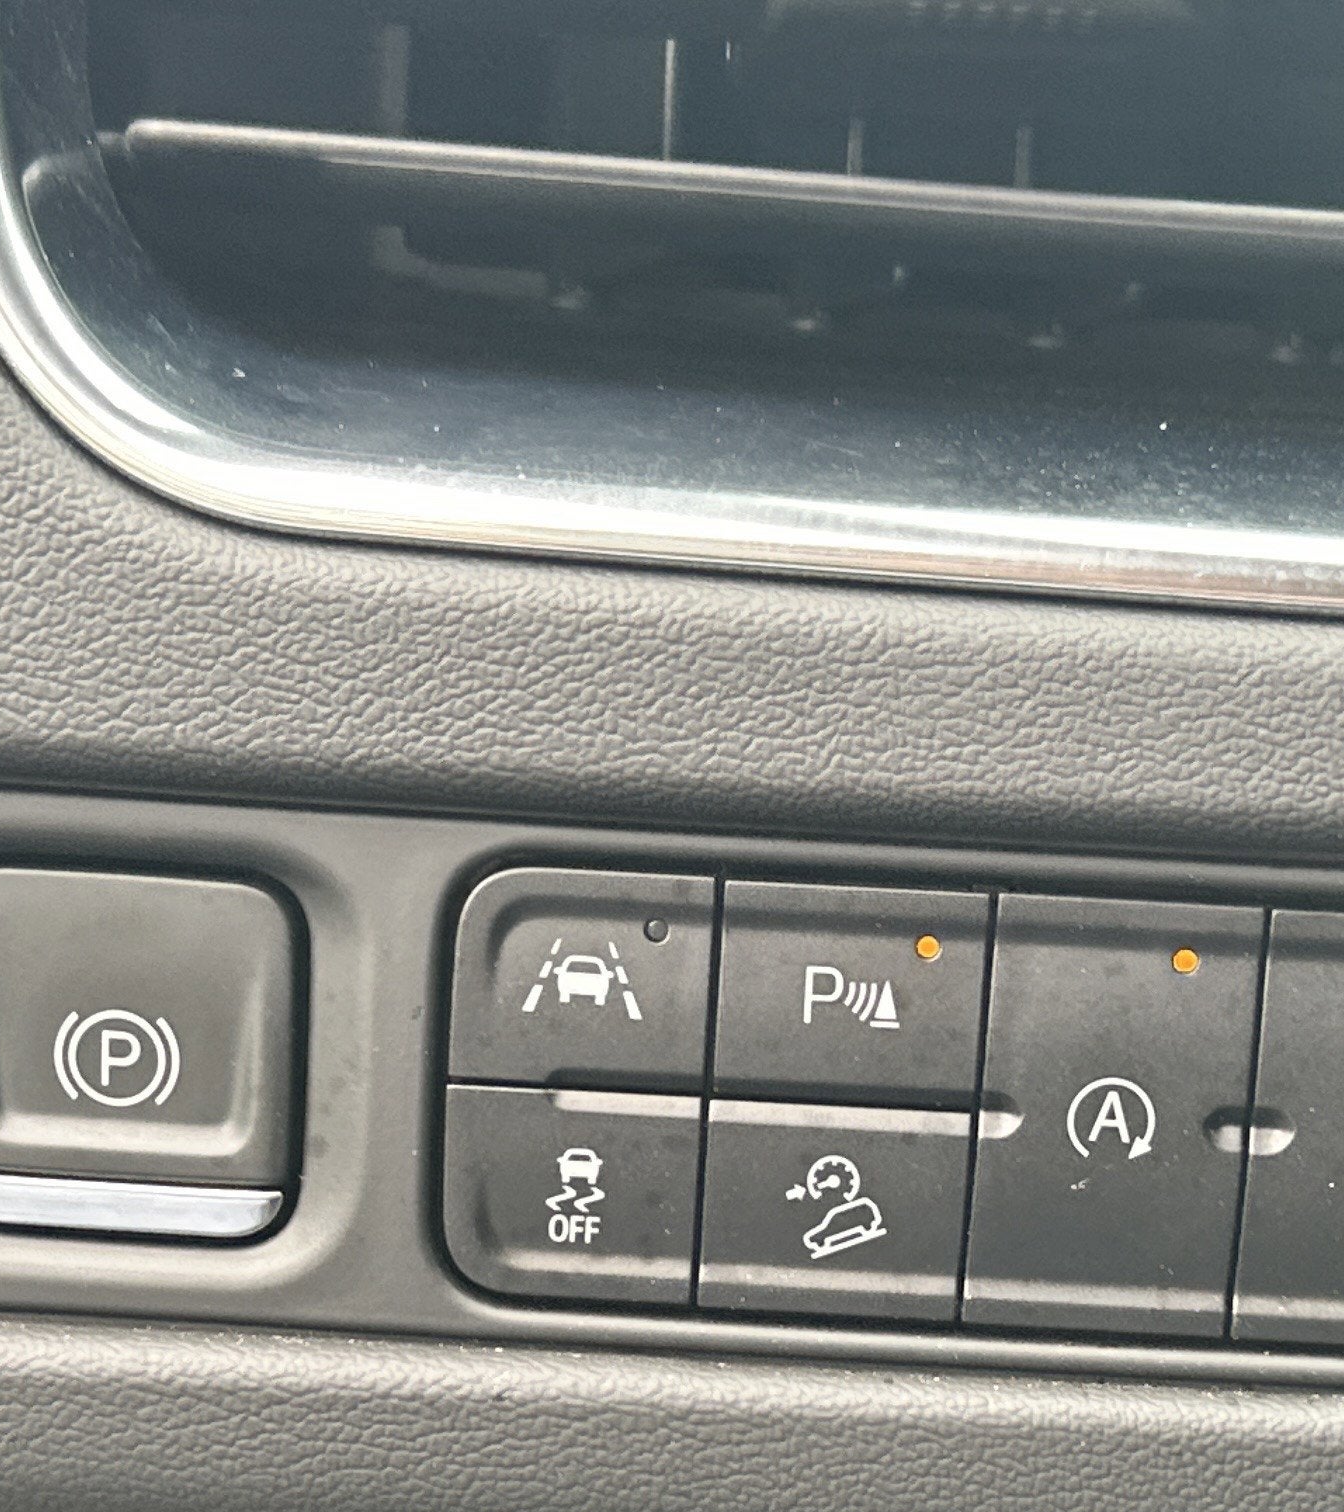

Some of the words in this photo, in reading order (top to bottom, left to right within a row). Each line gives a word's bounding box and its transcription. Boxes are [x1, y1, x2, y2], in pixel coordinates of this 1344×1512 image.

[803, 965, 845, 1024] P
[100, 1029, 142, 1087] P
[1087, 1090, 1131, 1145] A
[547, 1214, 601, 1245] OFF
